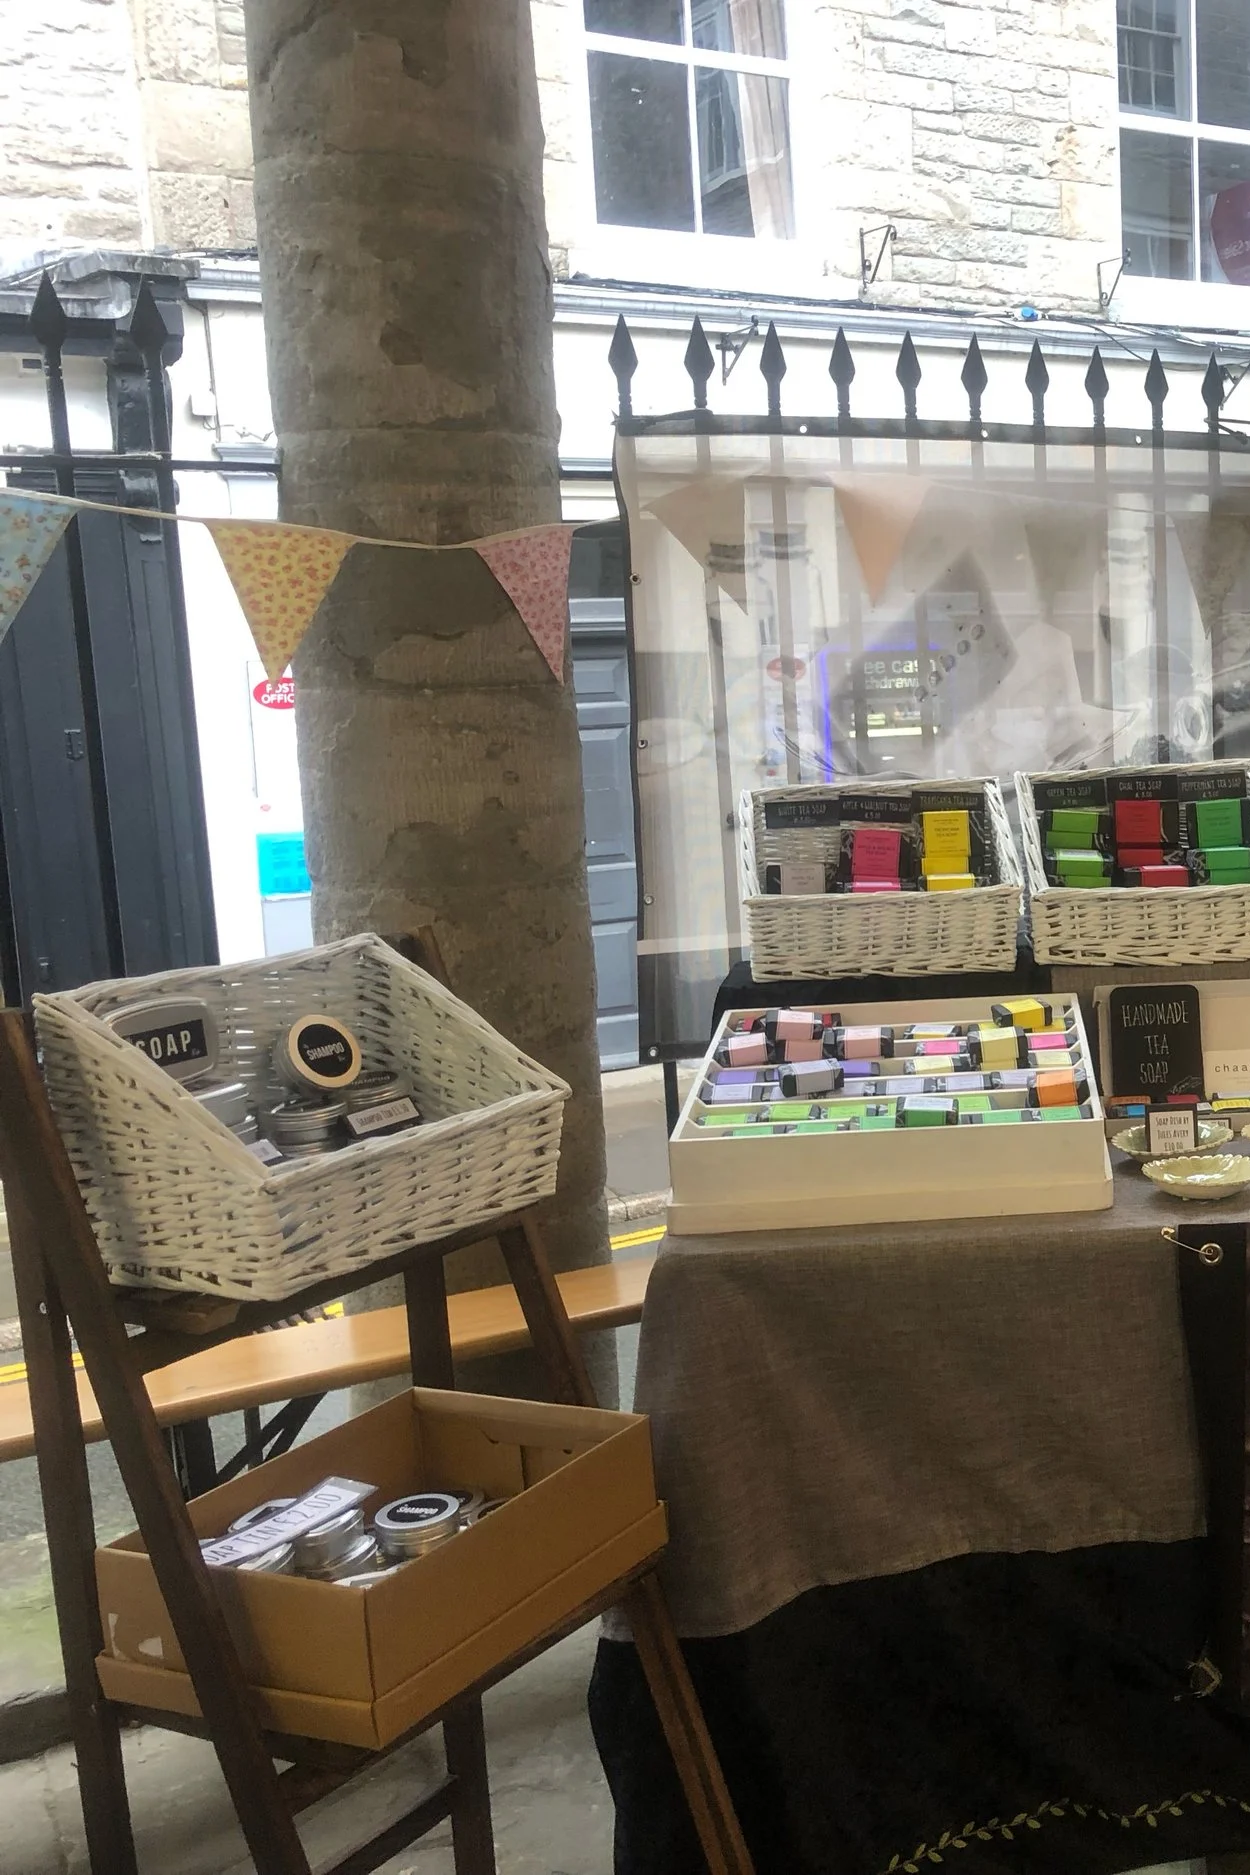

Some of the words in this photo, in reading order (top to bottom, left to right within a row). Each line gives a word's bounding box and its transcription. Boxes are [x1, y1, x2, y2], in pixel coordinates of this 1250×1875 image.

[261, 693, 295, 704] OFFIC
[1122, 1000, 1189, 1027] HANDMADE
[307, 1042, 345, 1061] SHAMPOO
[1144, 1034, 1170, 1055] TEA
[1140, 1062, 1169, 1084] SOAP
[1156, 1116, 1169, 1127] SOAP
[232, 1525, 285, 1546] TIN
